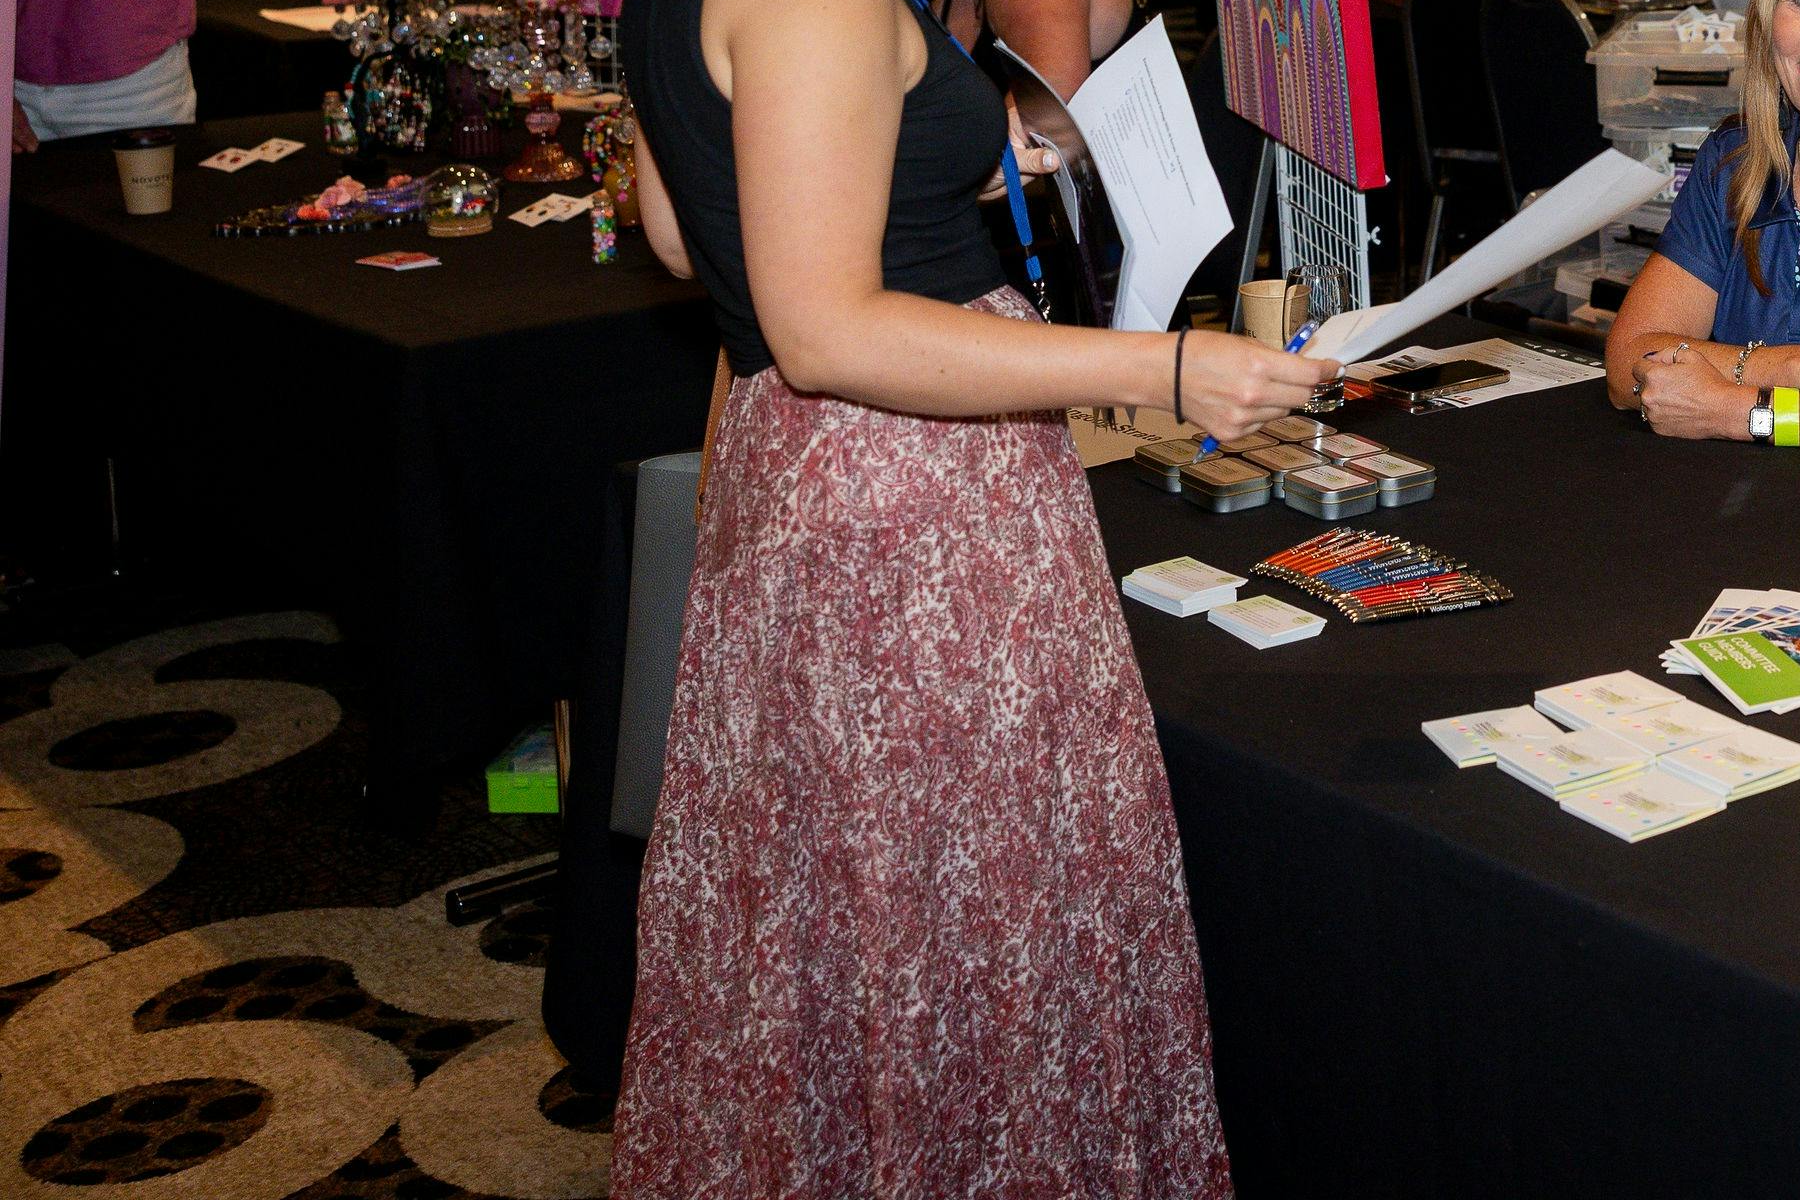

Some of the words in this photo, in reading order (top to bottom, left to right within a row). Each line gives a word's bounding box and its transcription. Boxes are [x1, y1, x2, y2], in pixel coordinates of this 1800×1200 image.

[1119, 424, 1162, 442] Strata
[1430, 603, 1463, 614] Wollongong
[1464, 599, 1481, 608] Strata
[1698, 642, 1728, 663] GUIDE
[1730, 637, 1781, 675] COMMITTEE
